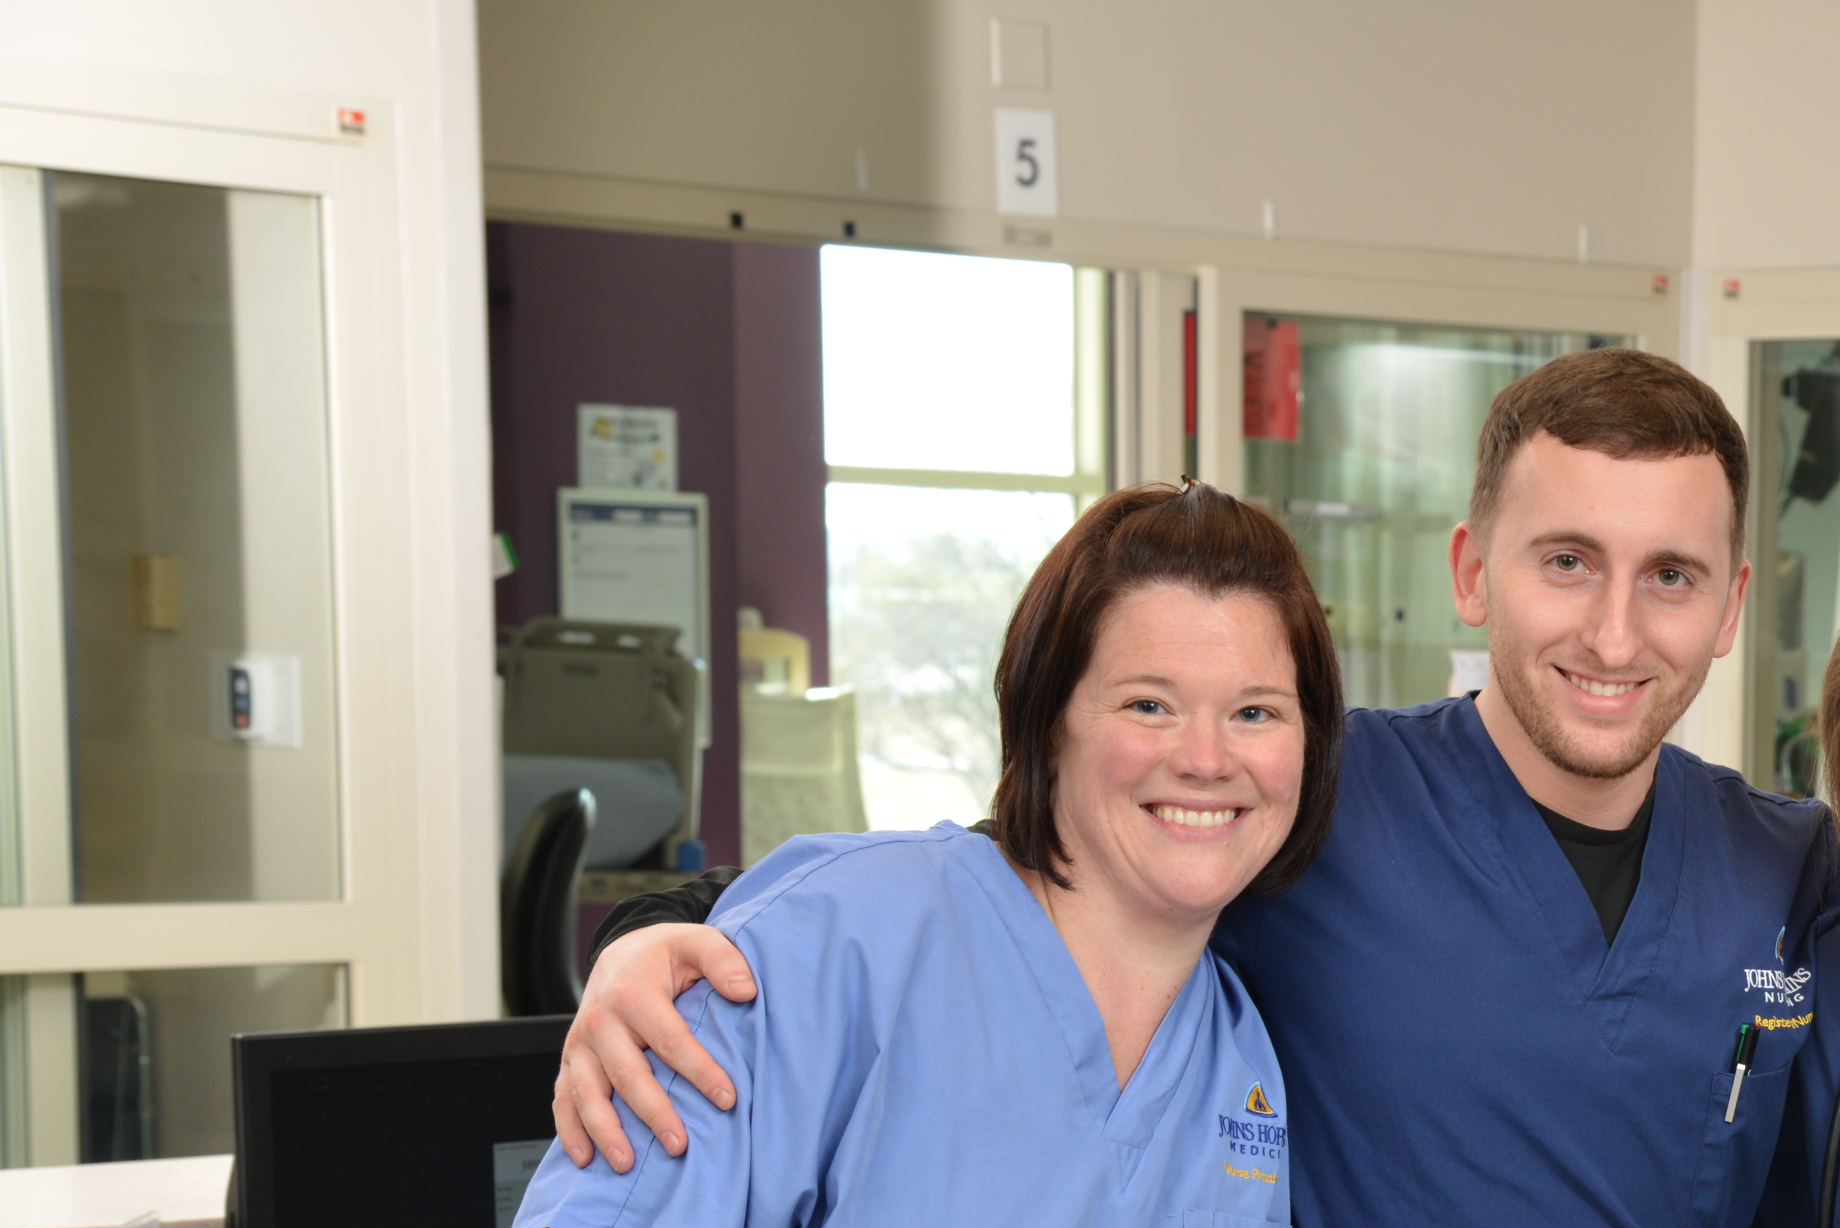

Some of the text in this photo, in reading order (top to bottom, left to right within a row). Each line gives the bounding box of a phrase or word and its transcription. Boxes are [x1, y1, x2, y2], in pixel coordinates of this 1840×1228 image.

[1015, 138, 1039, 187] 5
[1743, 968, 1785, 992] JOHNS
[1218, 1113, 1255, 1141] JOHNS
[1223, 1161, 1251, 1179] Nurse
